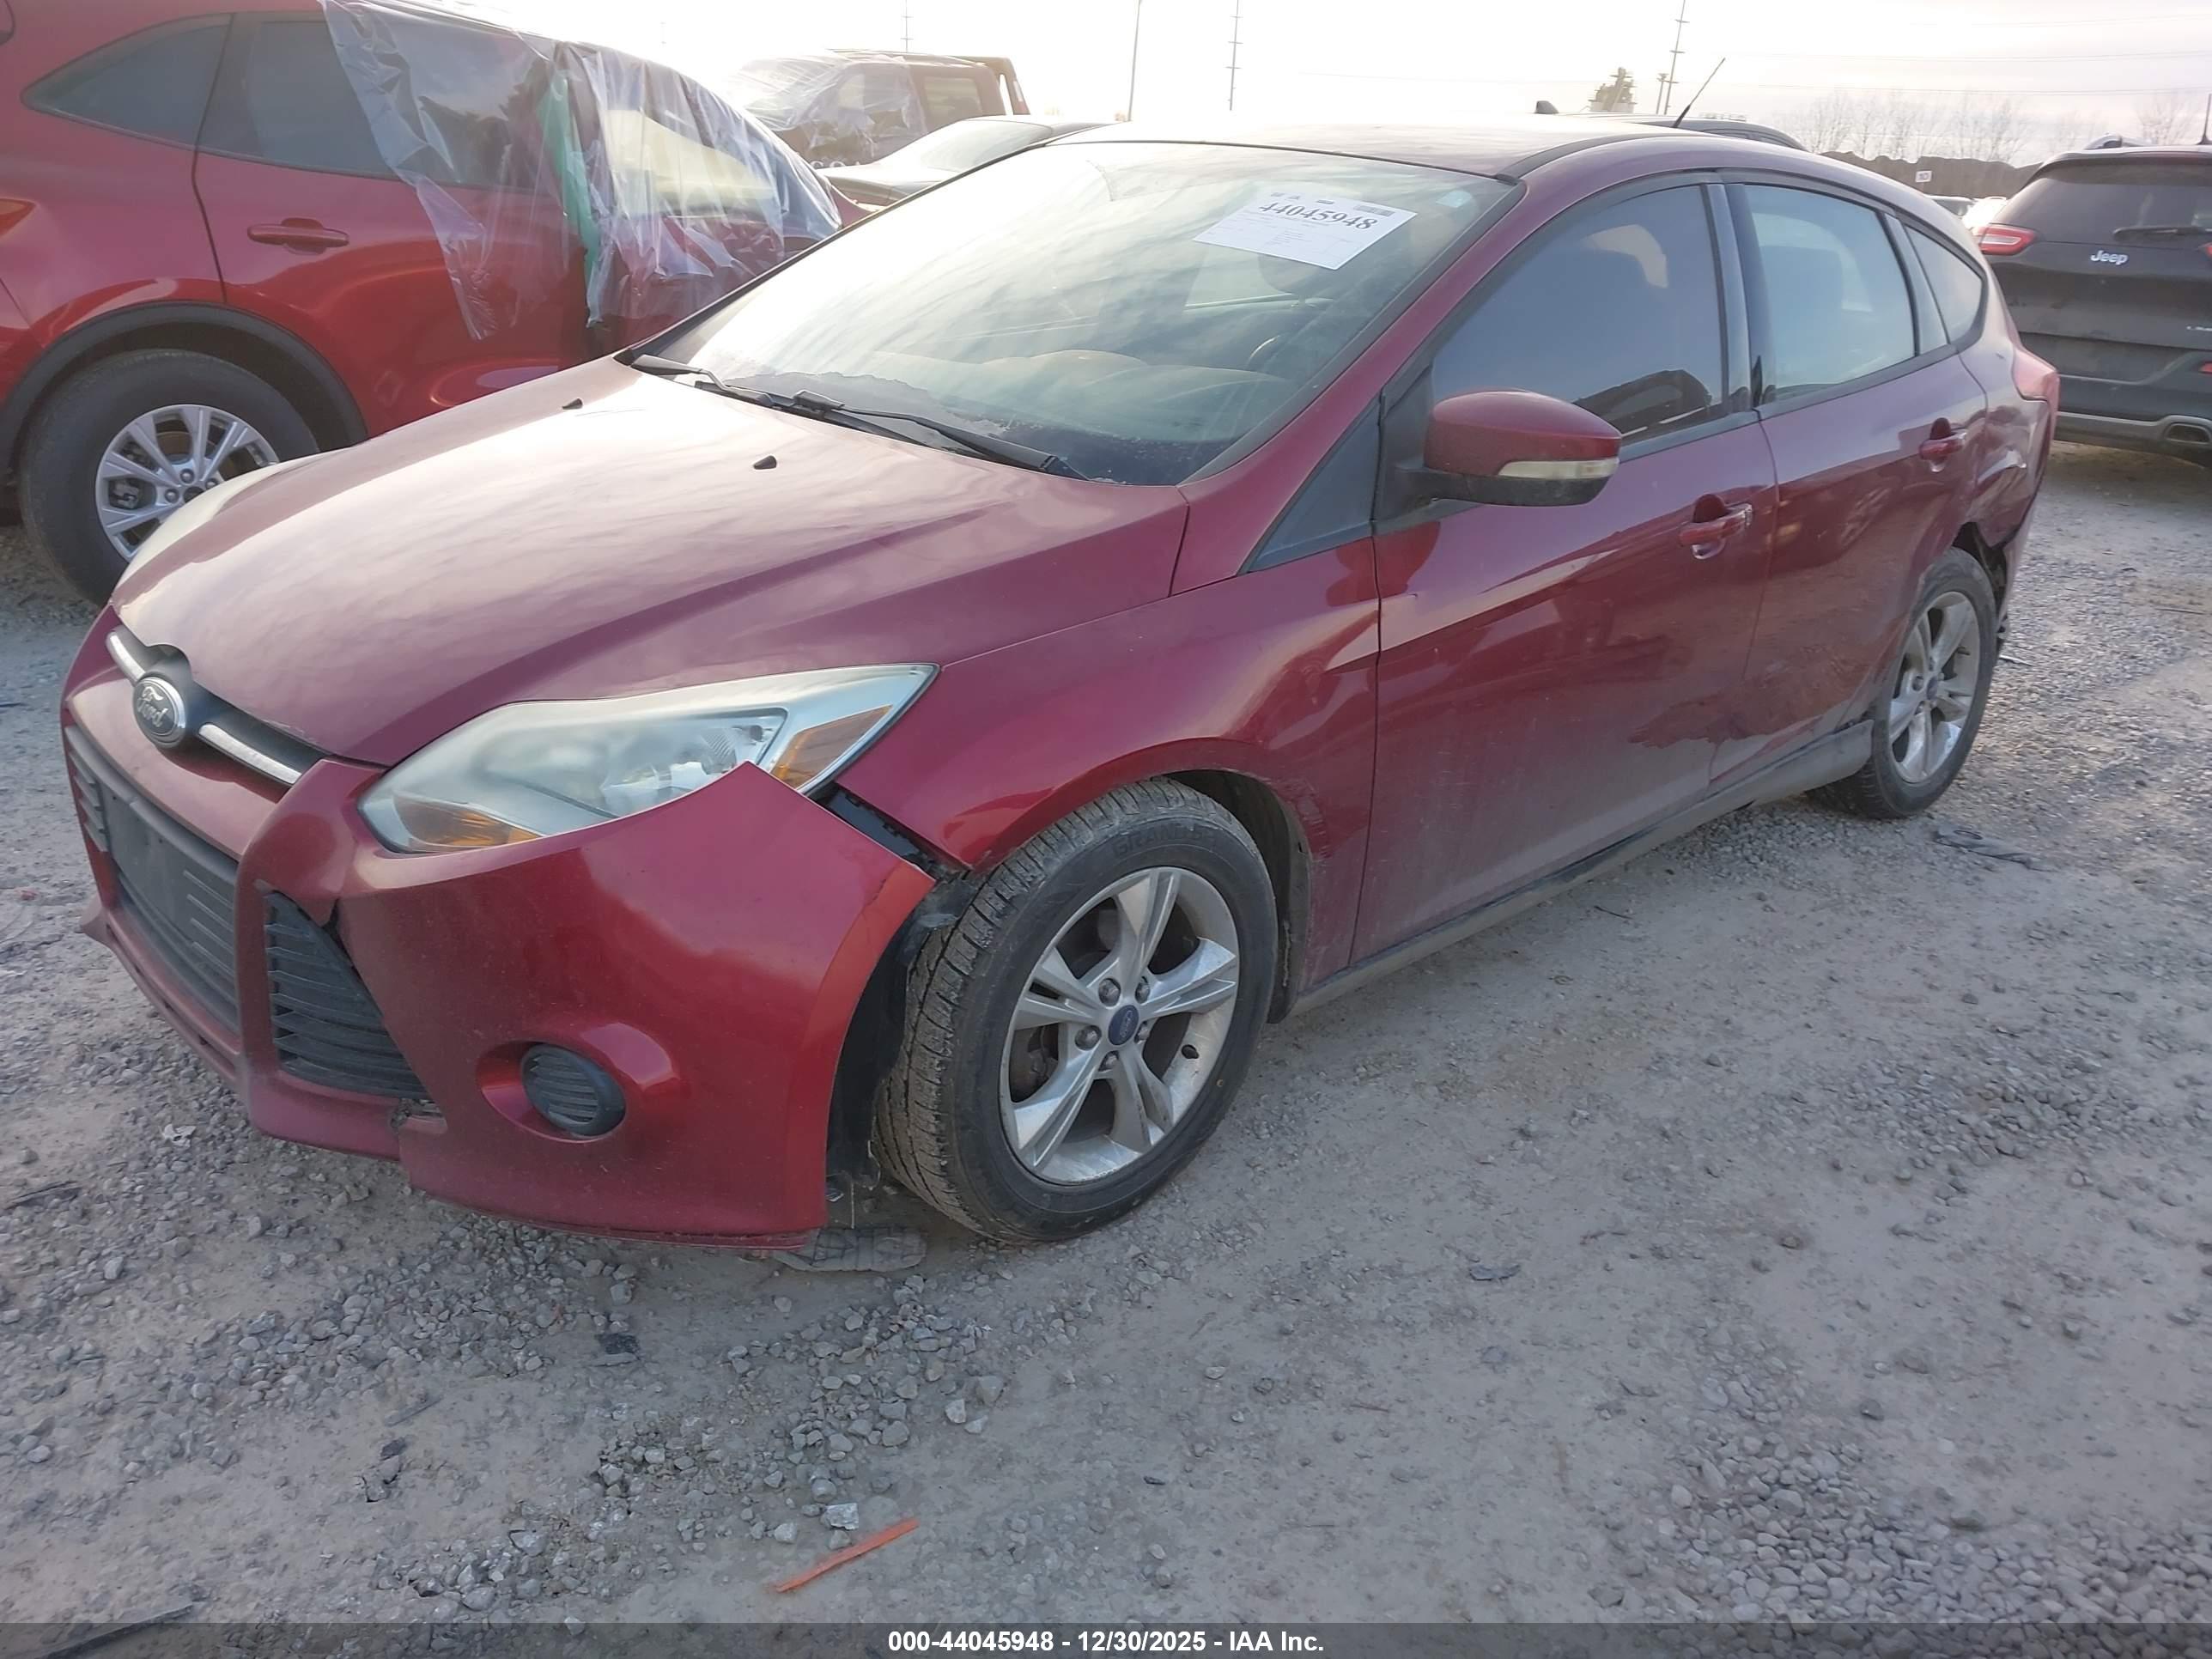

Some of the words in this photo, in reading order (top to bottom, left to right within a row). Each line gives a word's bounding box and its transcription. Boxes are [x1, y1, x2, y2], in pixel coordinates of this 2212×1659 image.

[1258, 201, 1378, 230] 44045948
[2090, 250, 2128, 265] Jeep
[137, 685, 170, 727] Ford
